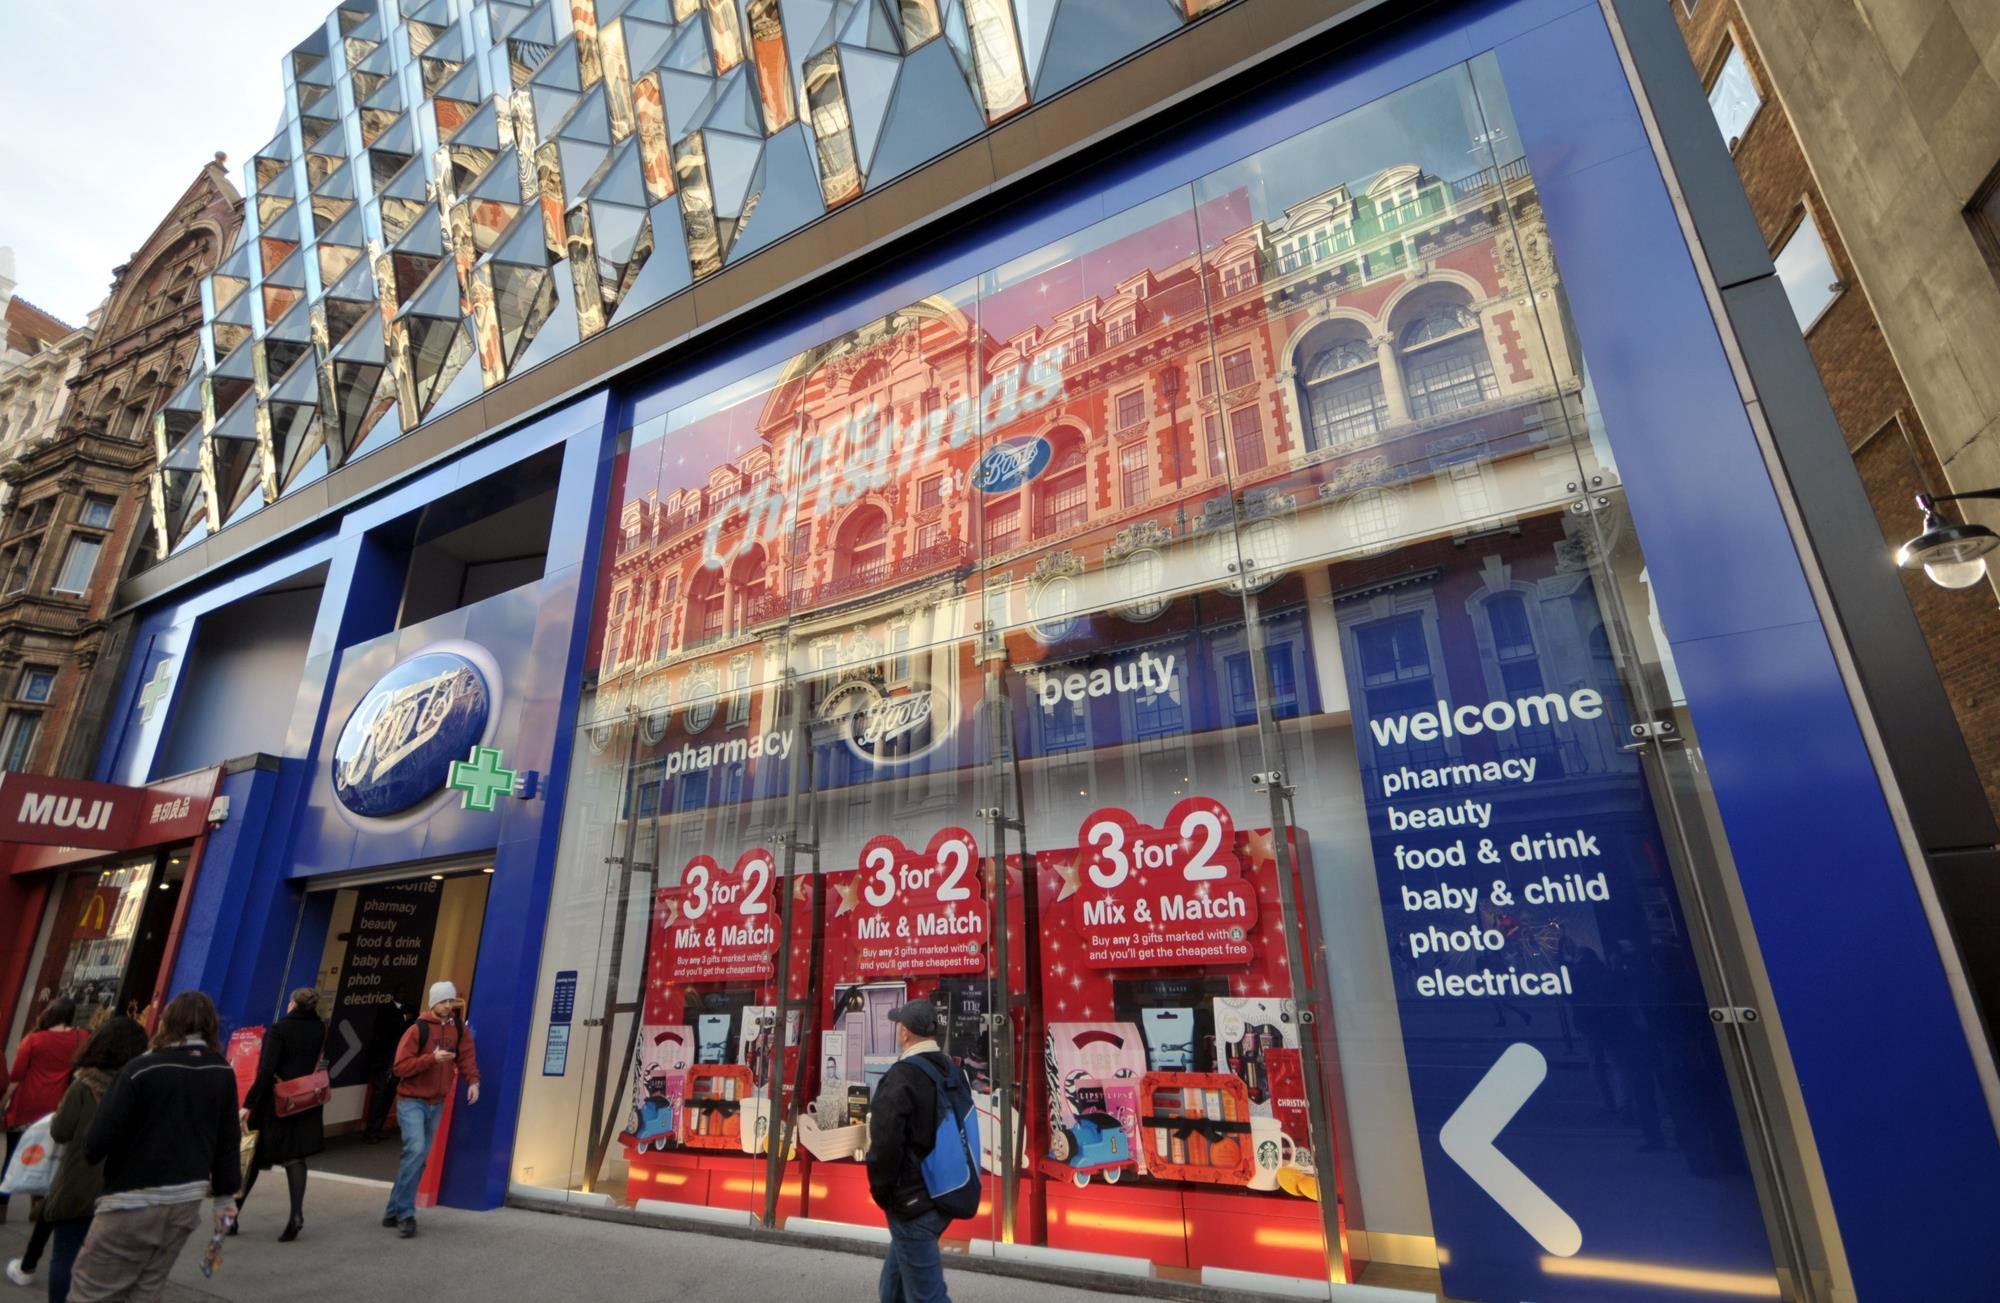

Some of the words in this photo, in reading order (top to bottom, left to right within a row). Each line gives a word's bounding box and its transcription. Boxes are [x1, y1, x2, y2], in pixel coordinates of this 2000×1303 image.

[938, 473, 964, 497] at
[979, 440, 1038, 488] Boots
[1039, 652, 1175, 707] beauty
[338, 669, 461, 791] Boots
[858, 690, 934, 746] Boots
[1369, 688, 1603, 747] welcome
[665, 730, 793, 780] pharmacy
[1382, 757, 1537, 797] pharmacy
[17, 792, 114, 831] MUJI
[149, 795, 191, 824] 無印良品
[1388, 800, 1492, 831] beauty
[1088, 821, 1129, 889] 3
[1132, 839, 1178, 869] for
[1180, 810, 1228, 881] 2
[1394, 840, 1466, 871] food
[1477, 838, 1501, 864] &
[1510, 829, 1601, 862] drink
[864, 848, 896, 907] 3
[899, 864, 934, 890] for
[936, 839, 970, 901] 2
[683, 865, 709, 919] 3
[711, 881, 740, 905] for
[739, 859, 769, 915] 2
[1402, 883, 1479, 914] baby
[1490, 880, 1515, 906] &
[1524, 872, 1610, 904] child
[364, 899, 417, 915] pharmacy
[1083, 898, 1126, 926] Mix
[1133, 899, 1152, 923] &
[1160, 890, 1246, 921] Match
[360, 917, 397, 933] beauty
[674, 928, 700, 949] Mix
[705, 928, 716, 947] &
[721, 923, 774, 946] Match
[858, 917, 890, 940] Mix
[896, 916, 910, 937] &
[917, 910, 982, 936] Match
[1092, 935, 1110, 947] Buy
[1112, 936, 1130, 947] any
[1133, 933, 1139, 944] 3
[1141, 932, 1163, 946] gifts
[1166, 930, 1204, 942] marked
[1207, 928, 1230, 940] with
[356, 935, 384, 948] food
[384, 936, 393, 948] &
[395, 935, 422, 949] drink
[863, 948, 877, 958] Buy
[879, 948, 893, 958] any
[895, 946, 899, 956] 3
[901, 946, 917, 957] gifts
[920, 944, 948, 954] marked
[951, 943, 968, 952] with
[1089, 950, 1107, 960] and
[1109, 948, 1136, 961] you'll
[1138, 949, 1155, 960] get
[1157, 946, 1173, 958] the
[1175, 944, 1223, 959] cheapest
[1225, 943, 1247, 954] free
[1409, 925, 1505, 958] photo
[352, 954, 380, 969] baby
[382, 955, 391, 966] &
[392, 954, 418, 966] child
[674, 968, 685, 976] and
[686, 967, 702, 977] you'll
[703, 967, 714, 977] get
[715, 966, 725, 975] the
[726, 965, 756, 975] cheapest
[677, 956, 688, 966] Buy
[689, 956, 700, 966] any
[702, 955, 706, 963] 3
[706, 955, 721, 966] gifts
[721, 953, 746, 963] marked
[747, 953, 762, 962] with
[860, 961, 874, 970] and
[875, 960, 896, 971] you'll
[897, 960, 910, 970] get
[911, 958, 923, 967] the
[925, 957, 962, 968] cheapest
[963, 956, 980, 965] free
[347, 973, 381, 987] photo
[1416, 965, 1573, 997] electrical
[344, 991, 393, 1006] electrica
[963, 1000, 980, 1014] mg
[1277, 1099, 1307, 1107] CHRISTM
